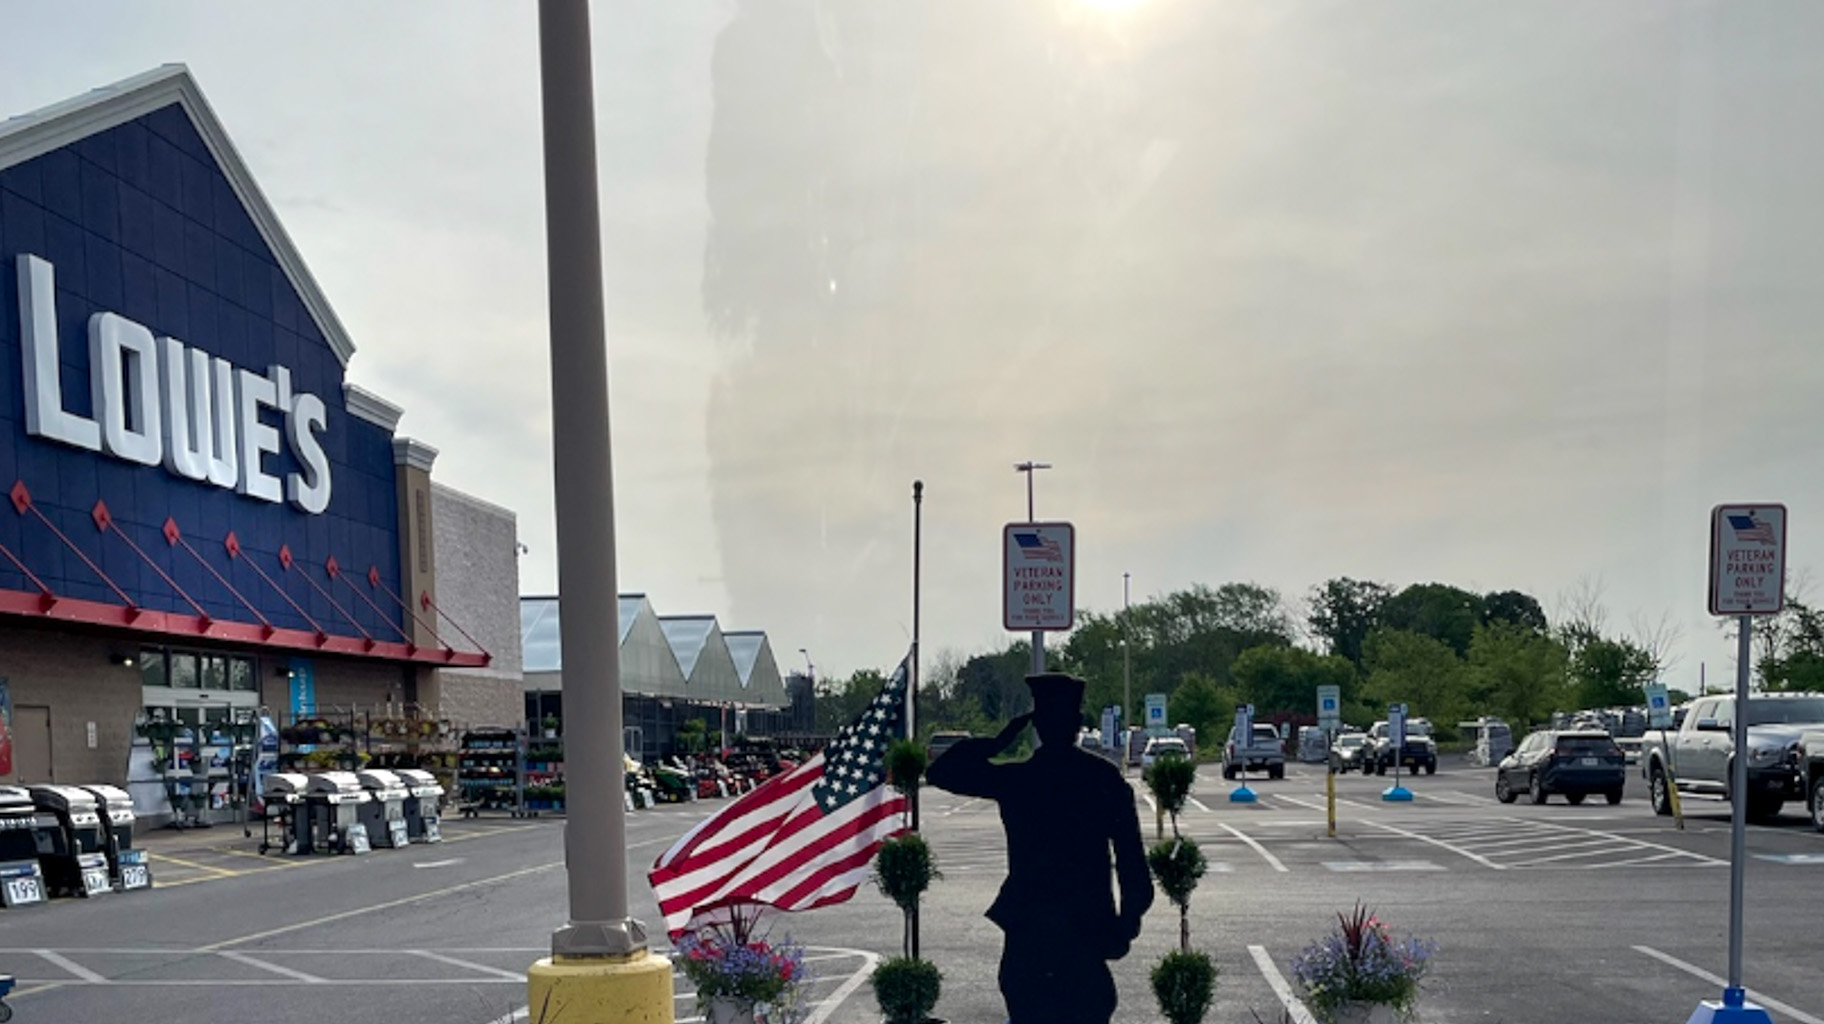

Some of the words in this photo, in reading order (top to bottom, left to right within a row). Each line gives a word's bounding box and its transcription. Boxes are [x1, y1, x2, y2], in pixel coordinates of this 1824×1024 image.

[16, 252, 332, 515] LOWE'S
[1726, 549, 1775, 561] VETERAN
[1013, 567, 1063, 579] VETERAN
[1726, 563, 1775, 575] PARKING
[1013, 579, 1063, 591] PARKING
[1735, 577, 1764, 588] ONLY
[1023, 593, 1053, 605] ONLY
[11, 880, 37, 899] 199
